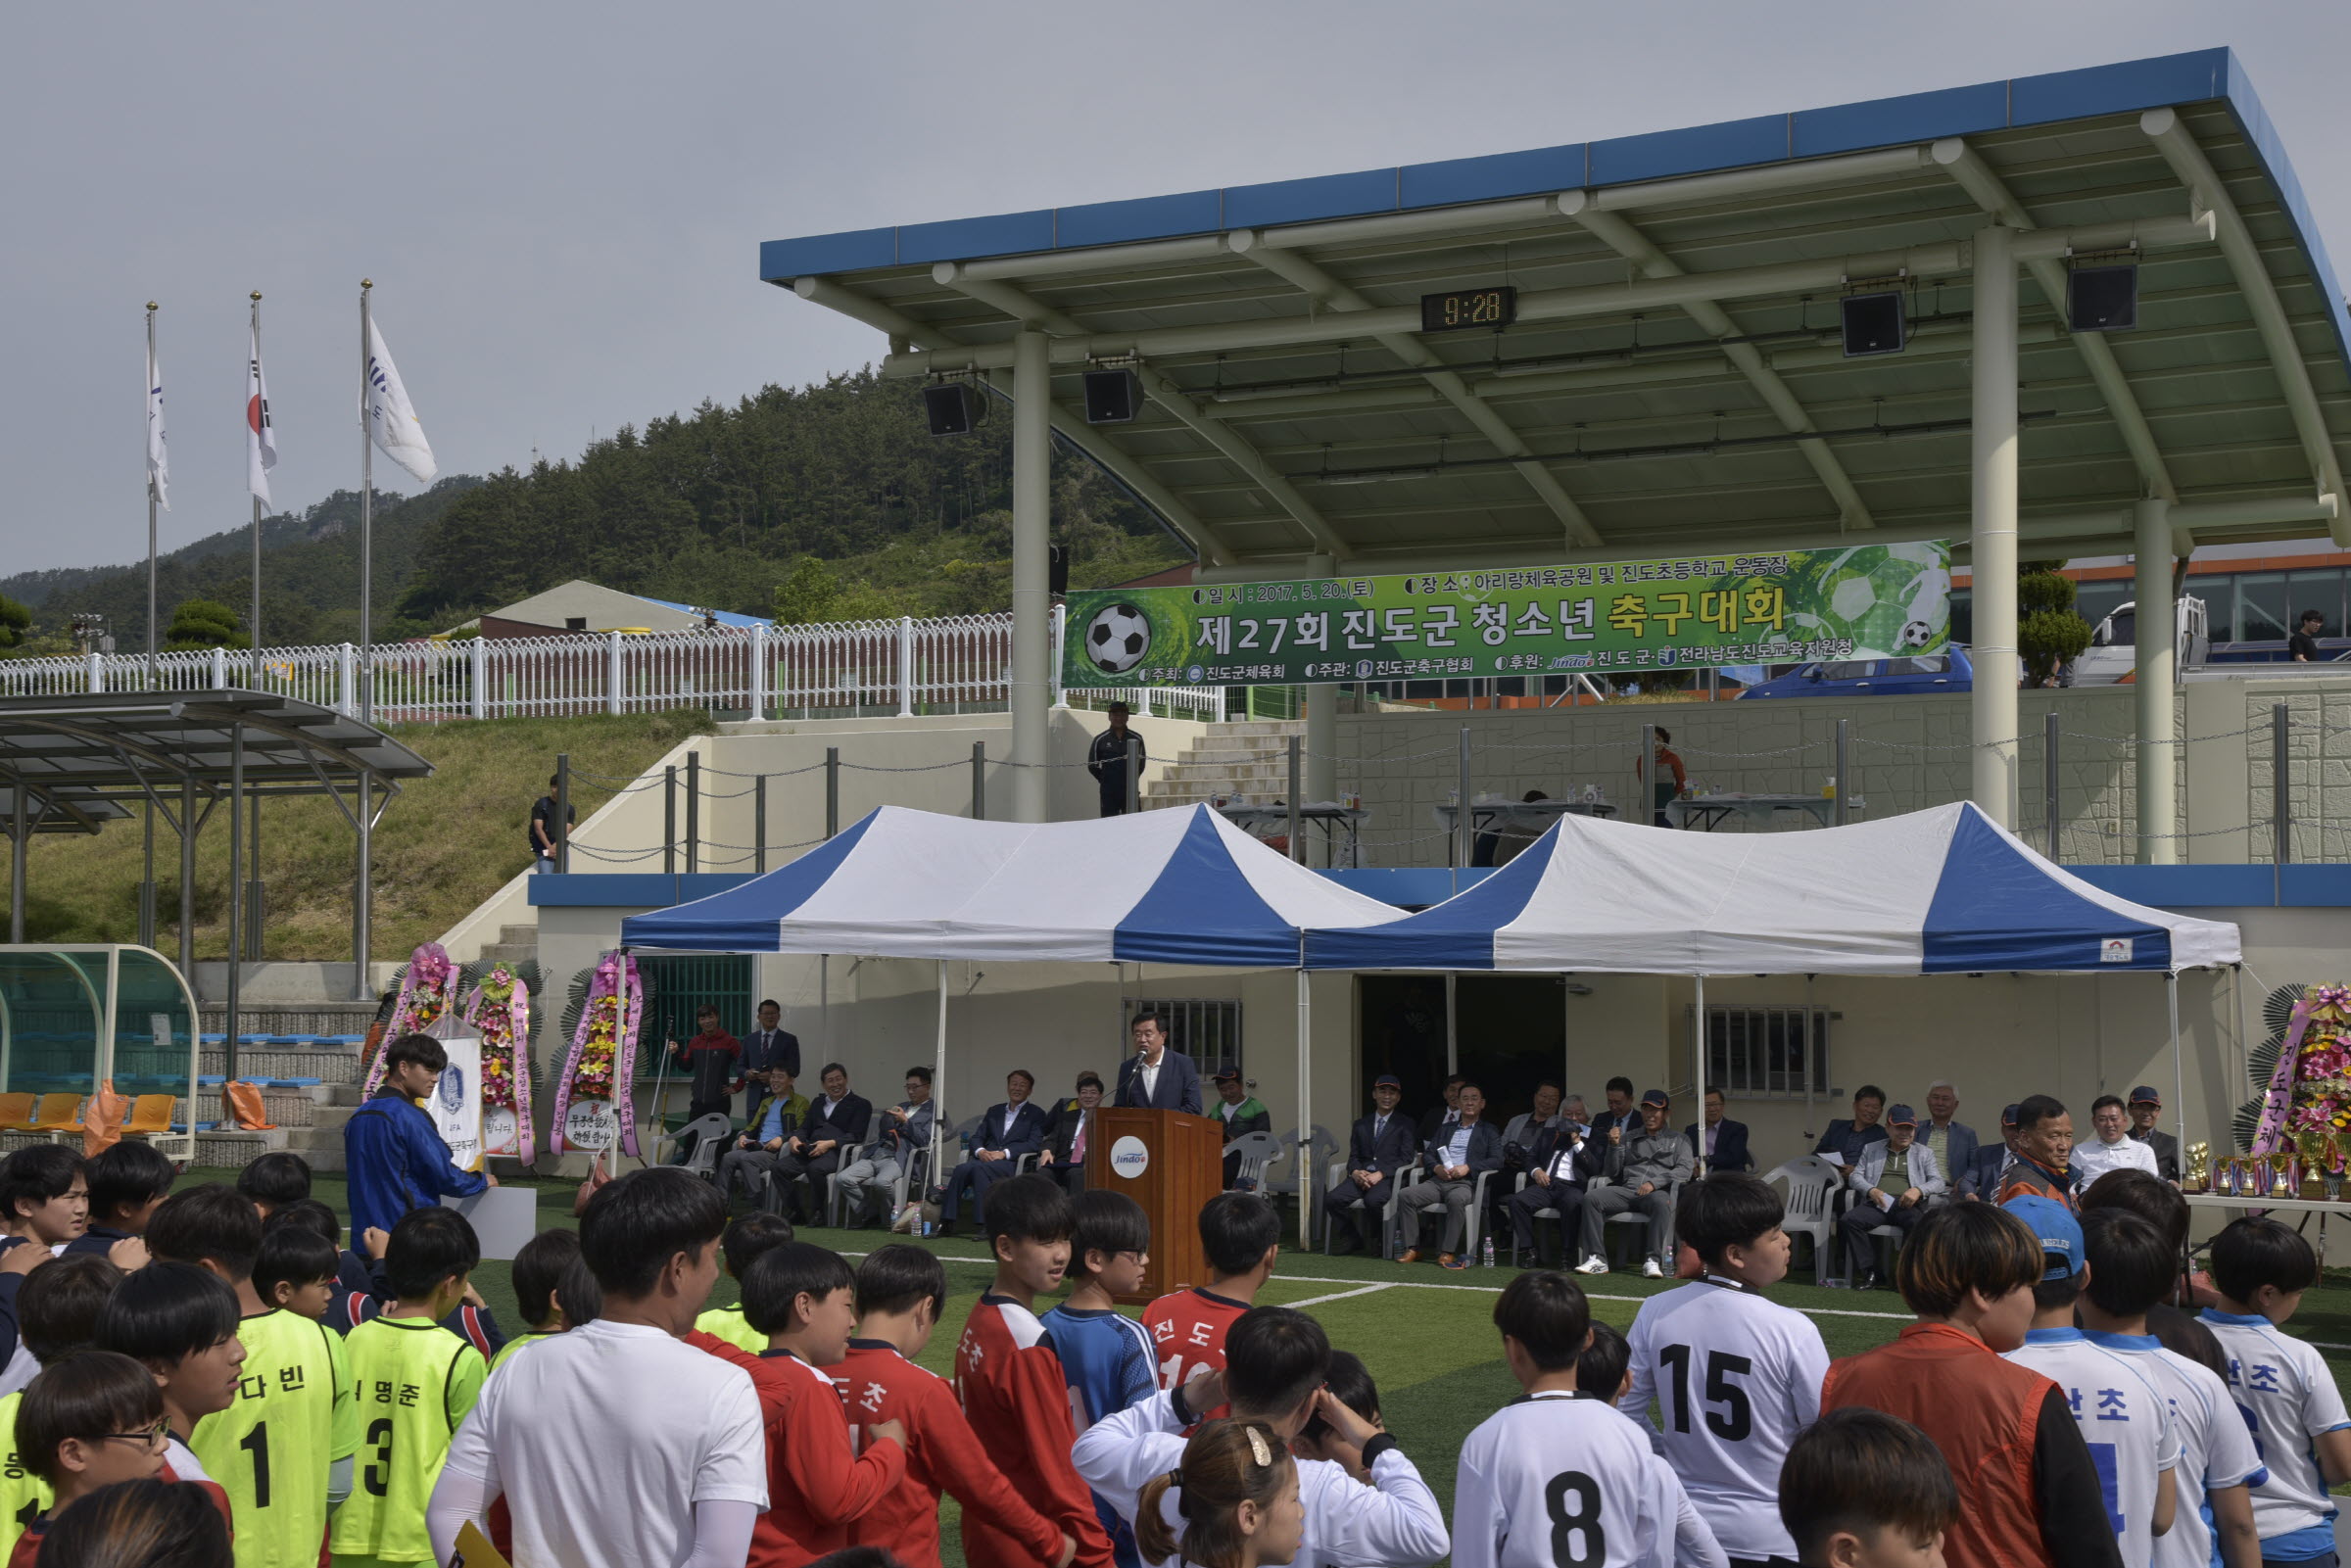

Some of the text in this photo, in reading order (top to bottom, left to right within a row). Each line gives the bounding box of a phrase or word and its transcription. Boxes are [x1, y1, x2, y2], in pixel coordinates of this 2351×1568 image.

[1445, 293, 1500, 325] 9:28
[1474, 567, 1592, 591] 아리랑체육공원
[1598, 566, 1614, 585] 및
[1621, 559, 1727, 584] 진도초등학교
[1733, 553, 1789, 576] 운동장
[1195, 587, 1784, 655] 제27회 진도군 청소년 축구대회
[1206, 664, 1285, 681] 진도군체육회
[1375, 656, 1473, 676] 진도군축구협회
[1547, 655, 1589, 670] Jindo
[1679, 638, 1852, 663] 전라남도진도교육지원청
[1114, 1153, 1142, 1164] Jindo
[1660, 1343, 1751, 1442] 15
[240, 1421, 270, 1508] 1
[364, 1417, 393, 1497] 3
[1545, 1470, 1606, 1568] 8
